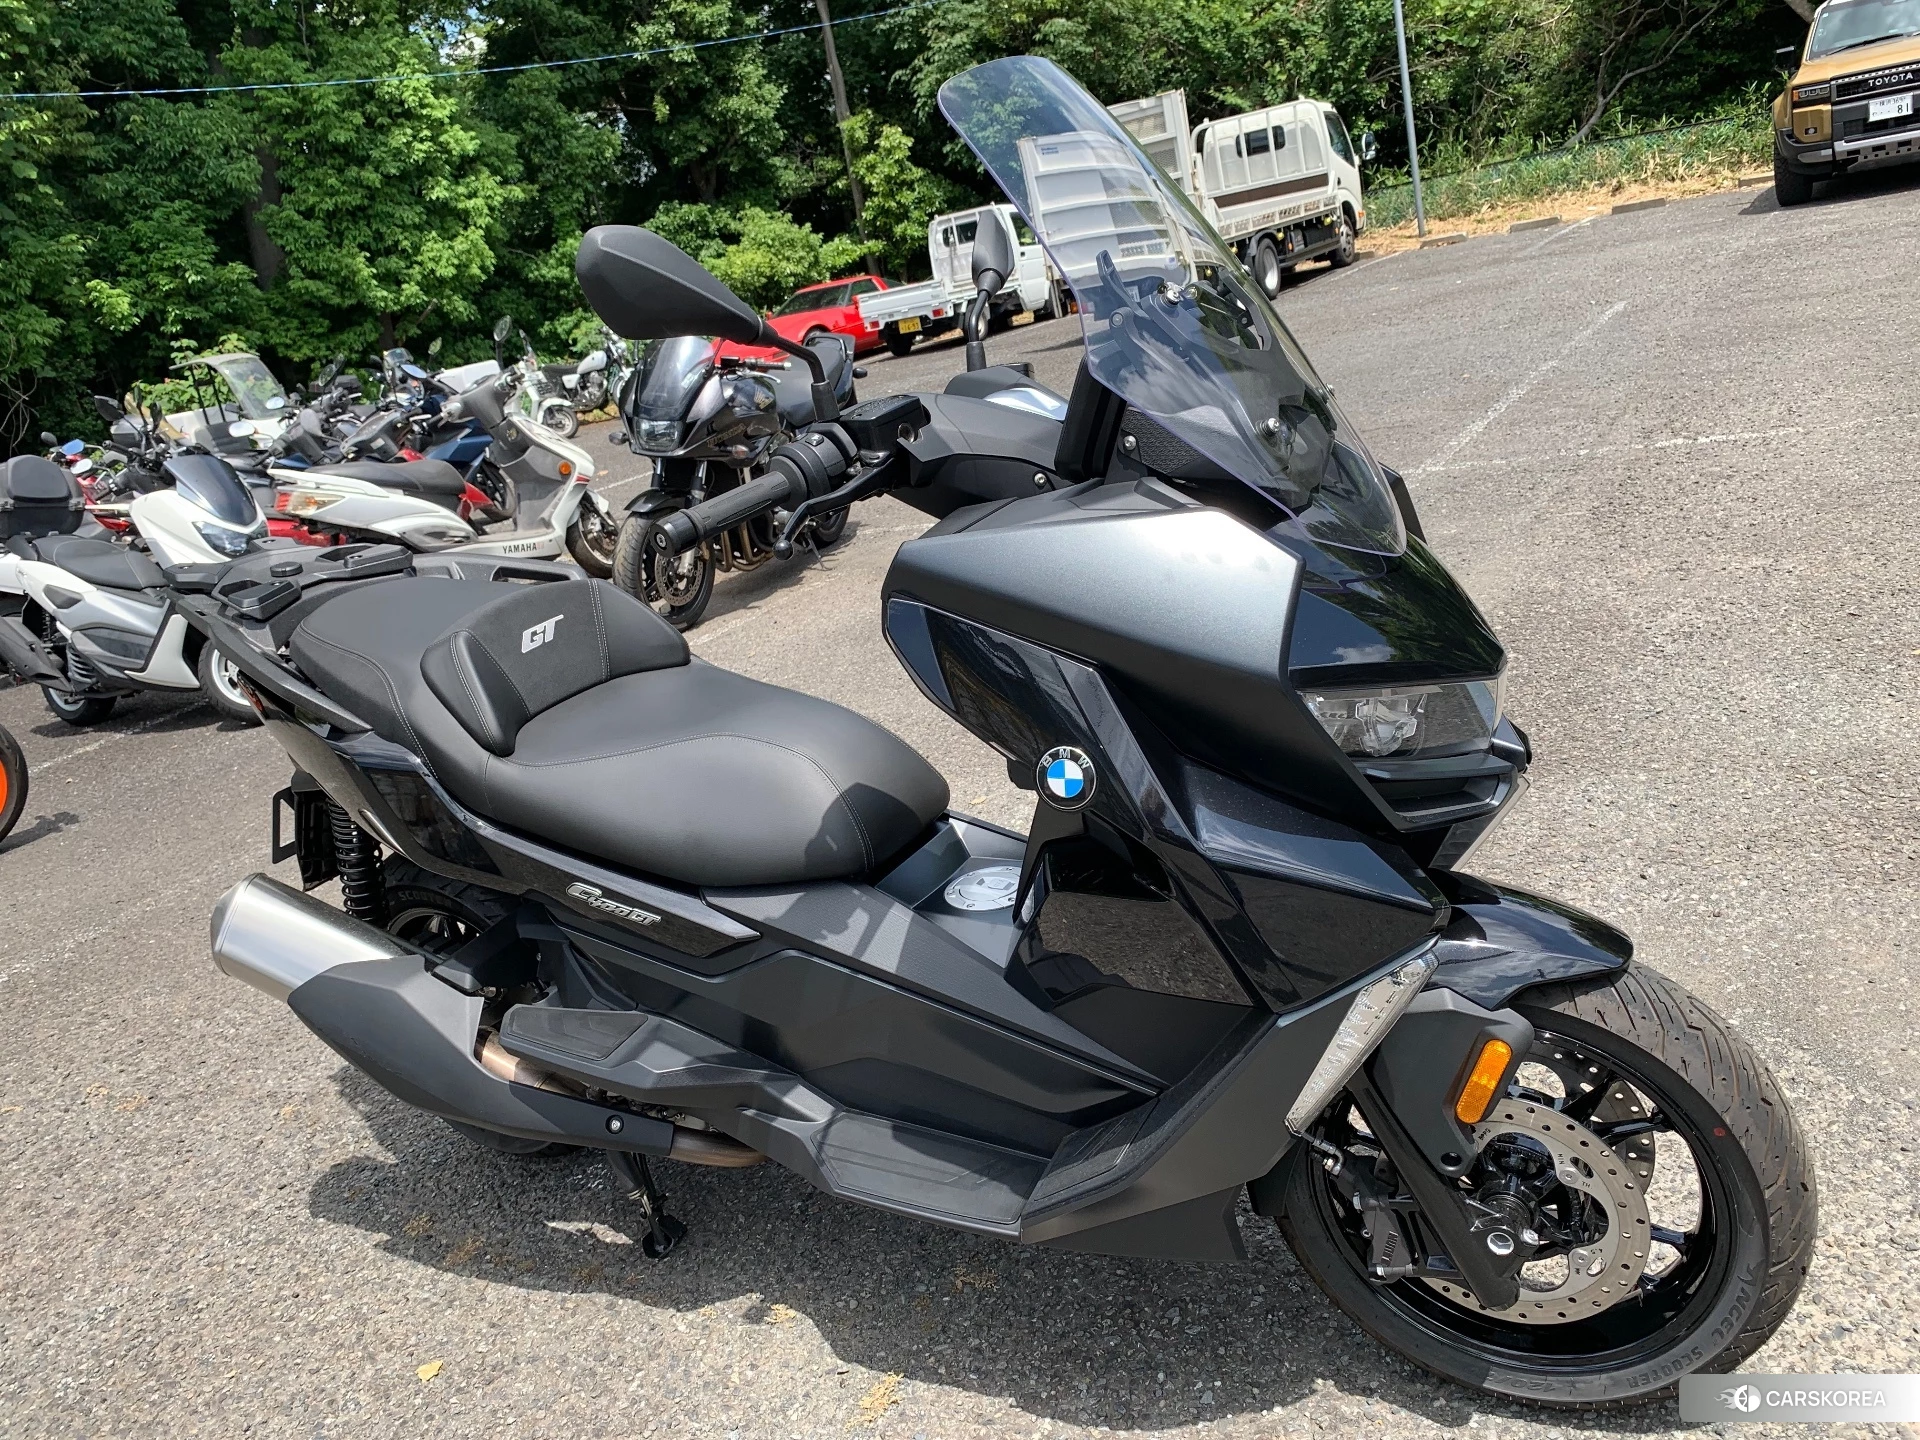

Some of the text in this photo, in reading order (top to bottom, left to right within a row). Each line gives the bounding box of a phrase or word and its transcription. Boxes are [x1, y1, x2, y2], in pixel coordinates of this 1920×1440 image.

[1868, 72, 1914, 87] TOYOTA
[502, 543, 538, 555] YAMAHA
[521, 614, 565, 654] GT
[1041, 748, 1091, 770] BMW
[1625, 1345, 1705, 1390] SCOOTER
